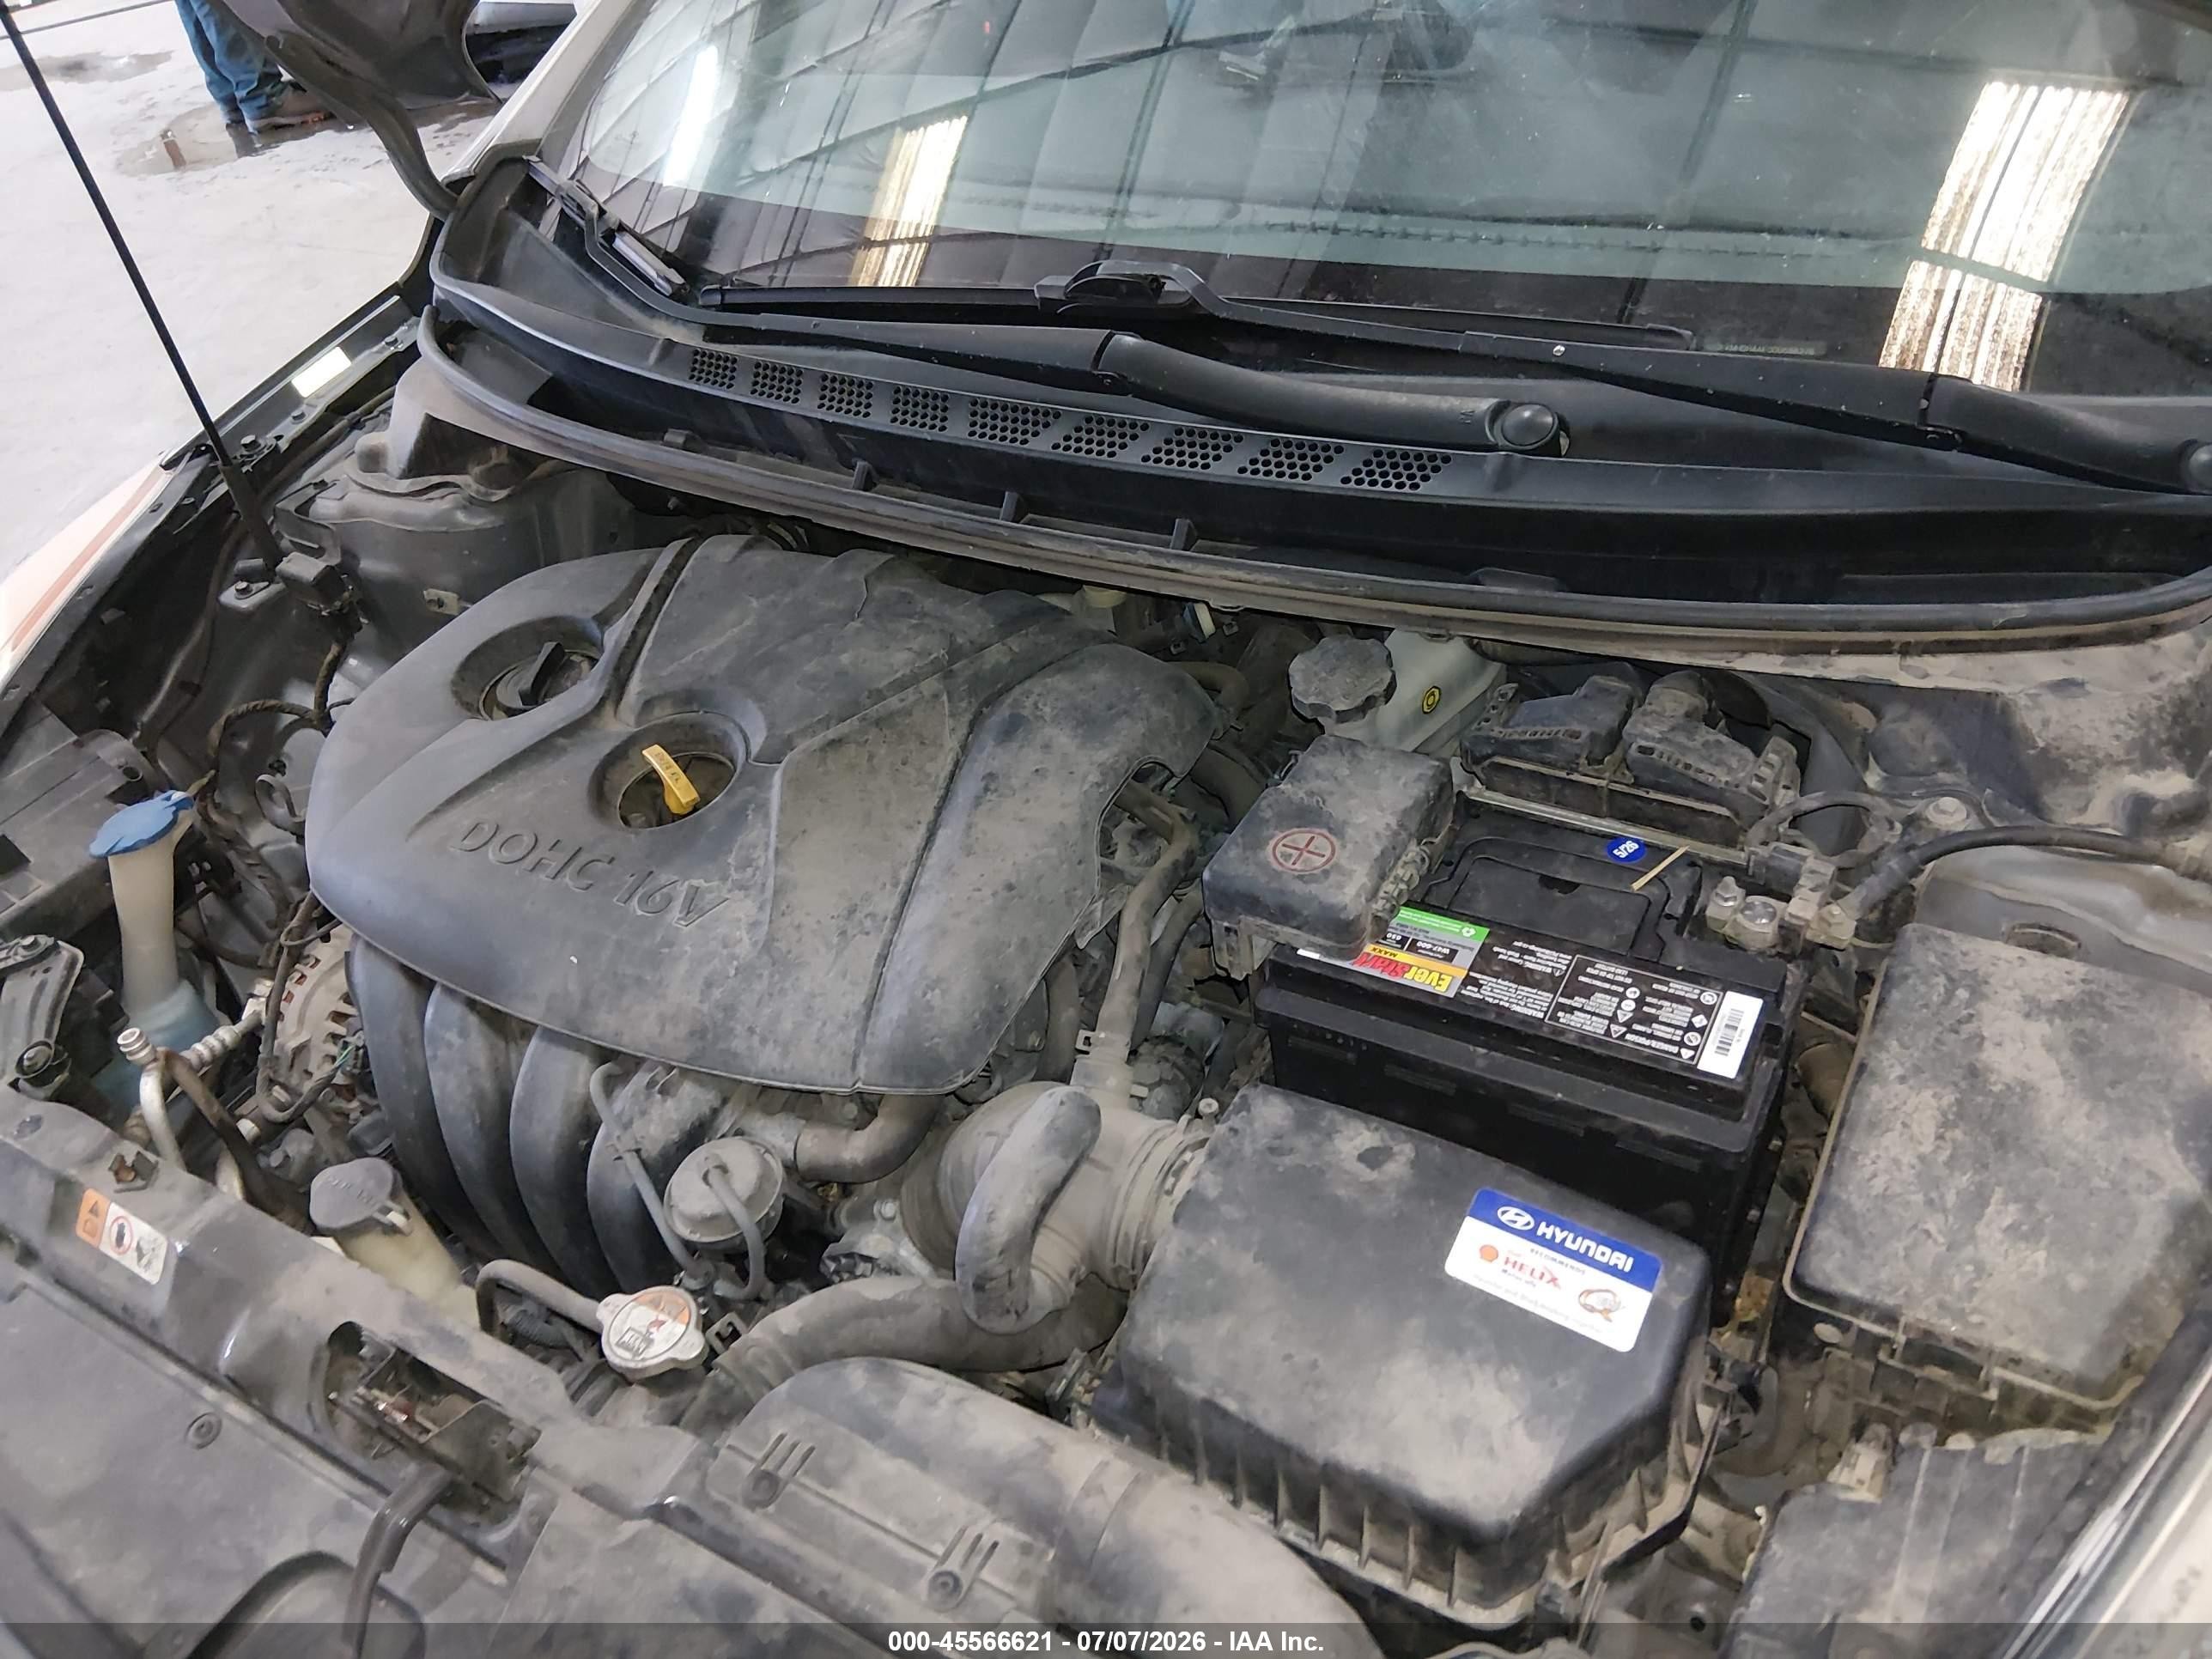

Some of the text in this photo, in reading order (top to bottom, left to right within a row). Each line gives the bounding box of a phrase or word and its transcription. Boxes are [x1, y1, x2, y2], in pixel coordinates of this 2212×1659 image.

[1613, 840, 1639, 858] 5/26
[449, 821, 730, 928] DOHC 16V
[1372, 947, 1398, 957] MAXX
[1536, 1221, 1633, 1273] HYUNDAI
[1504, 1256, 1560, 1289] HELIX
